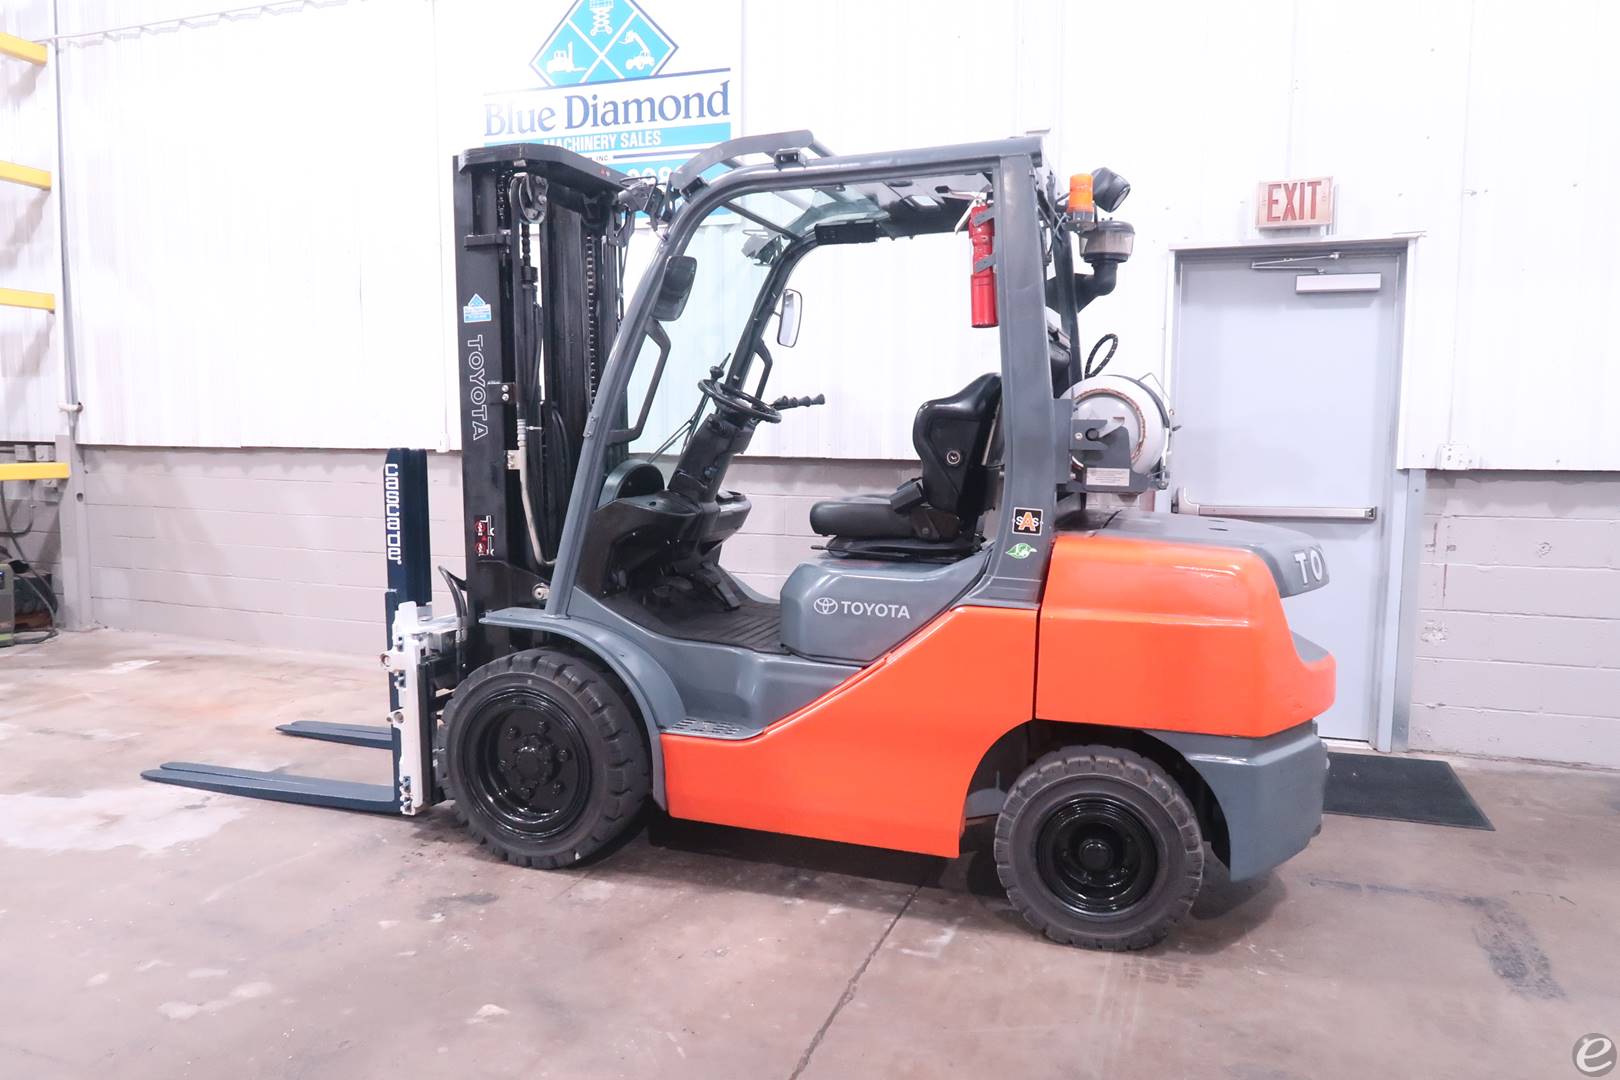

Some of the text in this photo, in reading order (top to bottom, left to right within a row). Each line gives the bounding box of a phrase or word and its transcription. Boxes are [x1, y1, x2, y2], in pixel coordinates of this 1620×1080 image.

[484, 80, 731, 136] Blue Diamond
[620, 130, 662, 148] SALES
[1266, 180, 1322, 222] EXIT
[467, 334, 489, 441] TOYOTA
[1015, 511, 1040, 532] SAS
[841, 600, 911, 619] TOYOTA
